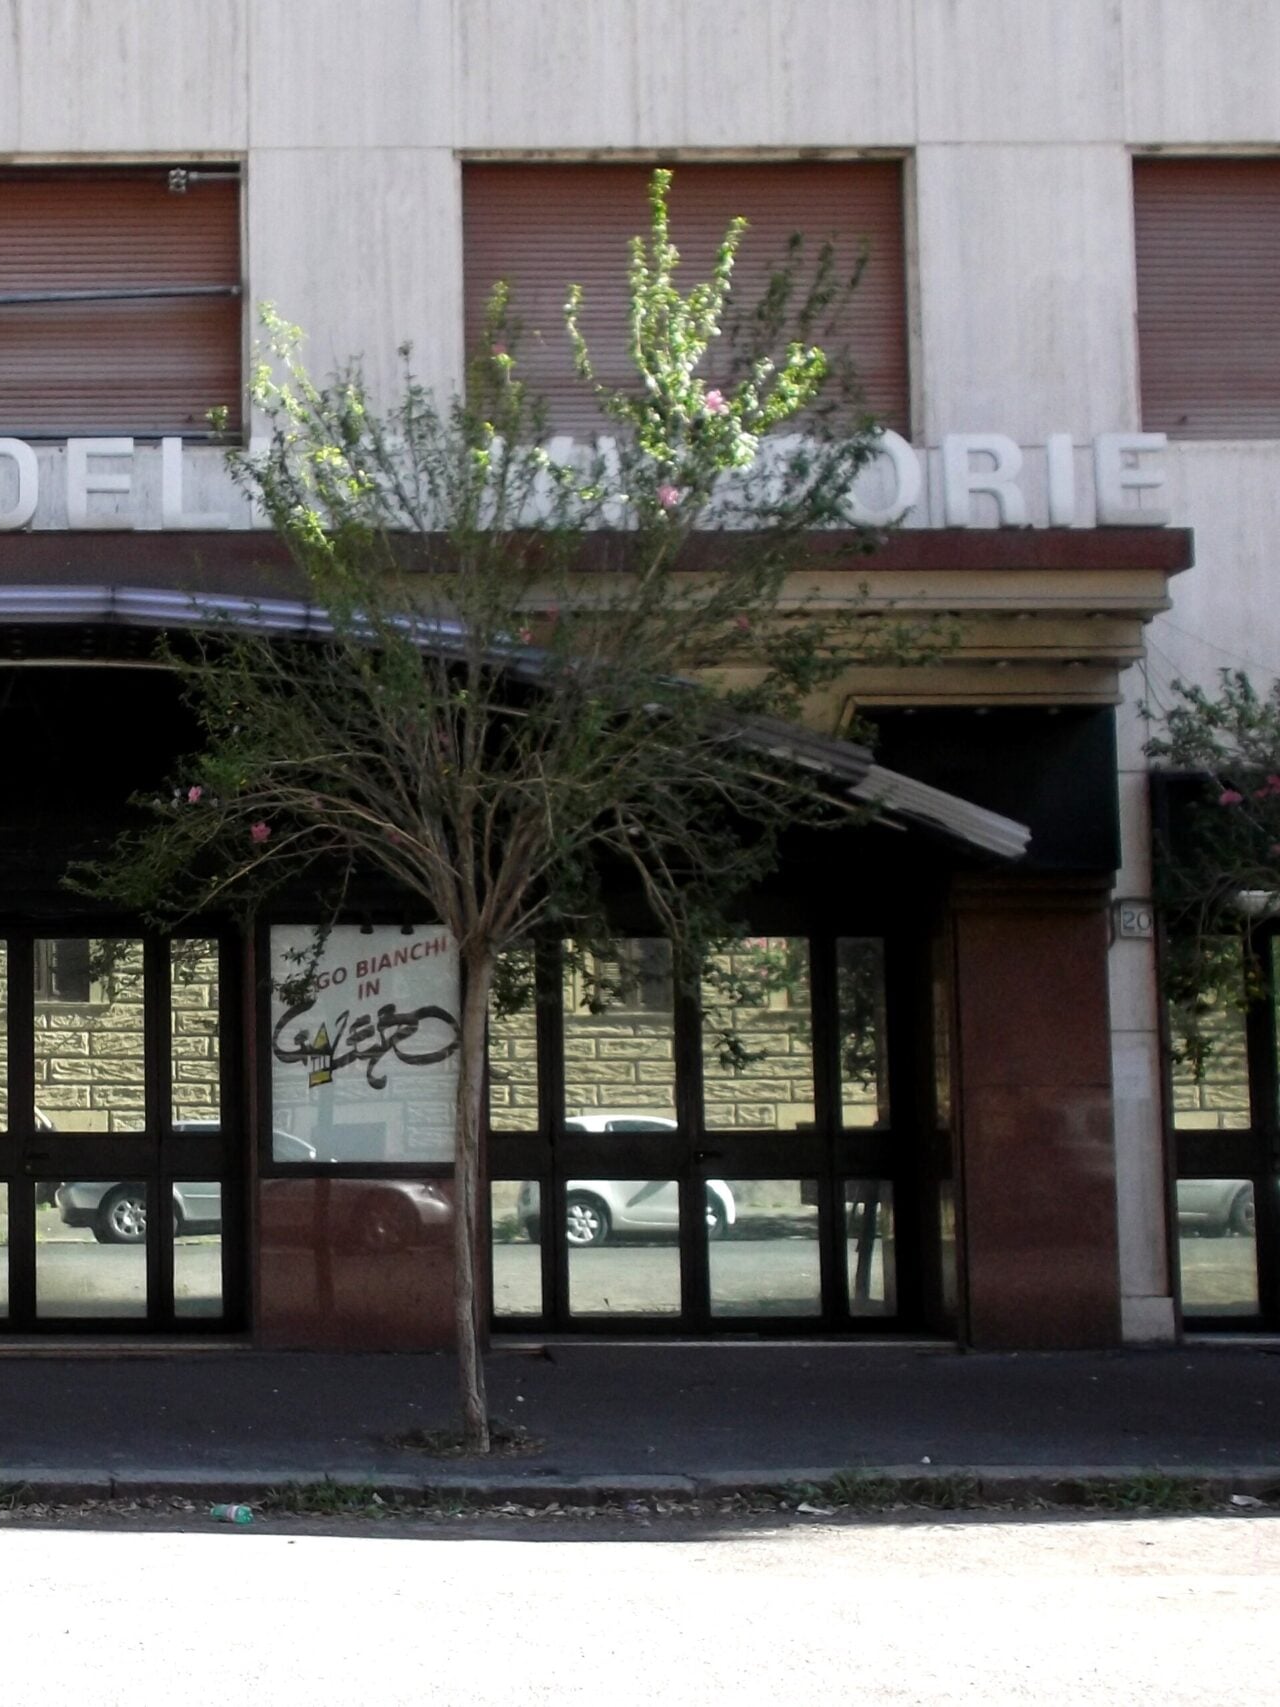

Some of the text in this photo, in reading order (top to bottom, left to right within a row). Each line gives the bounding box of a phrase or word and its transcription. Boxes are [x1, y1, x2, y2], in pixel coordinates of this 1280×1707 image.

[1122, 911, 1152, 931] 20
[356, 936, 448, 978] BIANCHI
[358, 979, 380, 1000] IN
